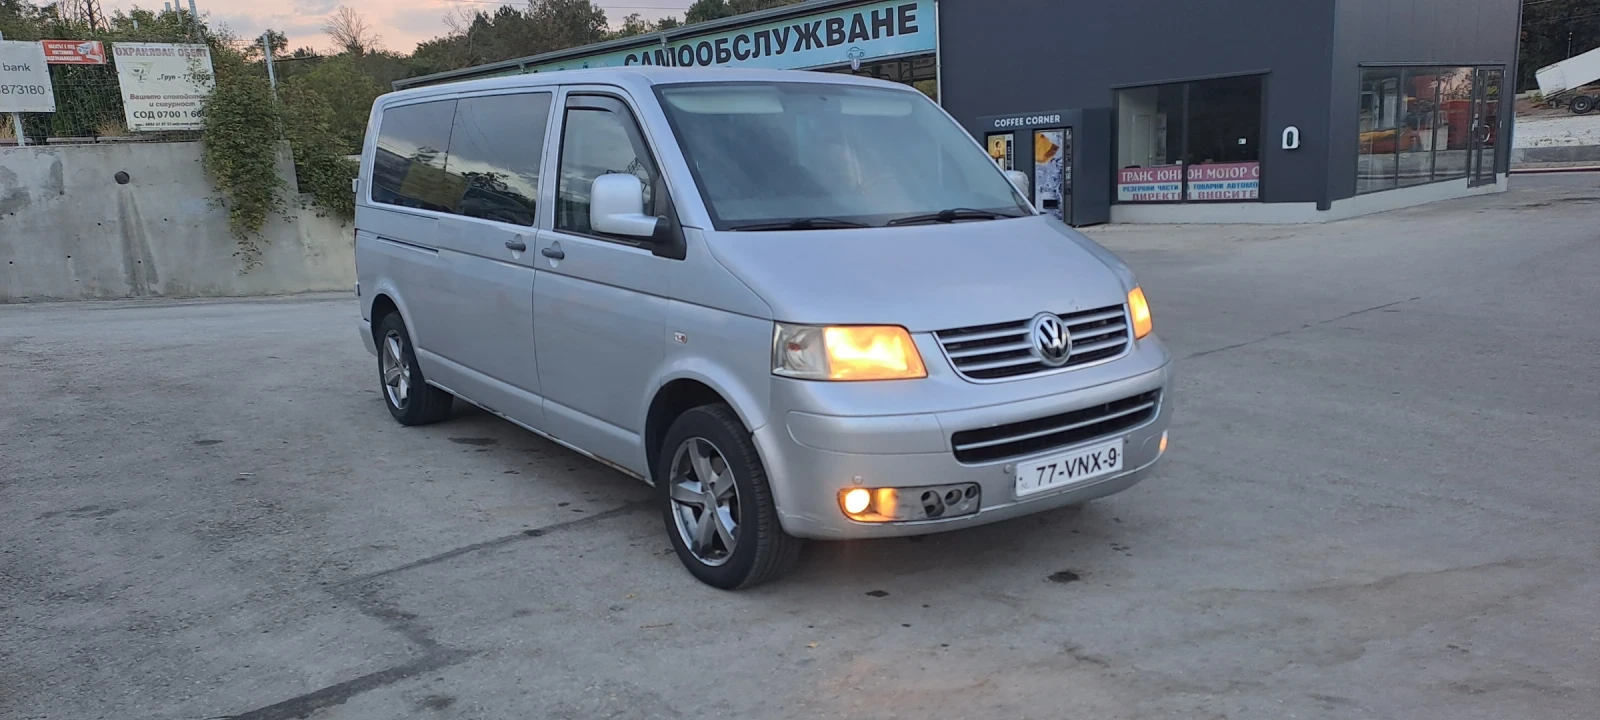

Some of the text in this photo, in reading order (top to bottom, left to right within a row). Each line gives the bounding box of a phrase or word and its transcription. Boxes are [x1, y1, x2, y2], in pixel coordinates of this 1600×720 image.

[115, 47, 175, 57] ОХРАНЯВАН
[2, 62, 31, 72] bank
[0, 84, 45, 95] 873180
[133, 110, 155, 120] СОД
[157, 110, 180, 118] 0700
[183, 110, 188, 118] 1
[994, 114, 1061, 128] COFFEE CORNER
[1121, 171, 1153, 182] ТРАНС
[1206, 166, 1248, 179] МОТОР
[1036, 447, 1118, 487] 77-VNX-9
